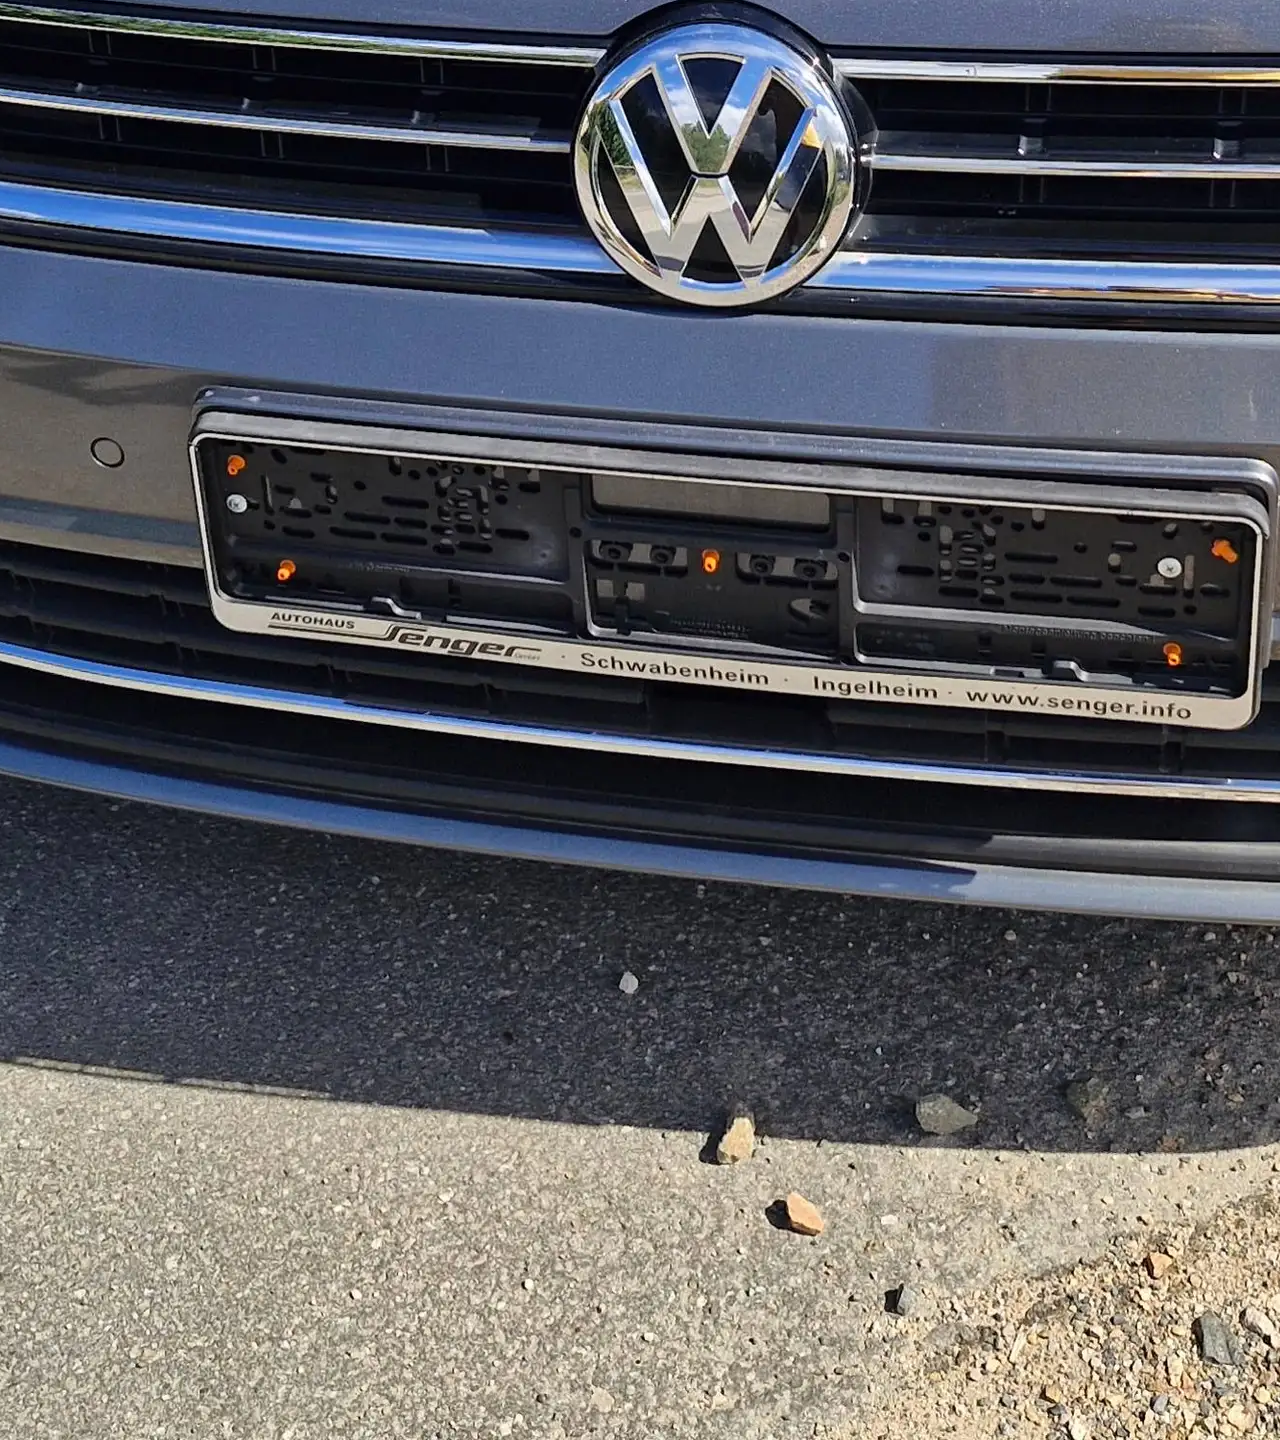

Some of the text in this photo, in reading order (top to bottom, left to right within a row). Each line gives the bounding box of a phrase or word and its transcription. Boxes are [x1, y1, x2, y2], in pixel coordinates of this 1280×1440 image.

[271, 612, 355, 629] AUTOHAUS
[384, 623, 542, 656] Senger
[580, 652, 1192, 721] Schwabenheim Ingelheim www.senger.info
